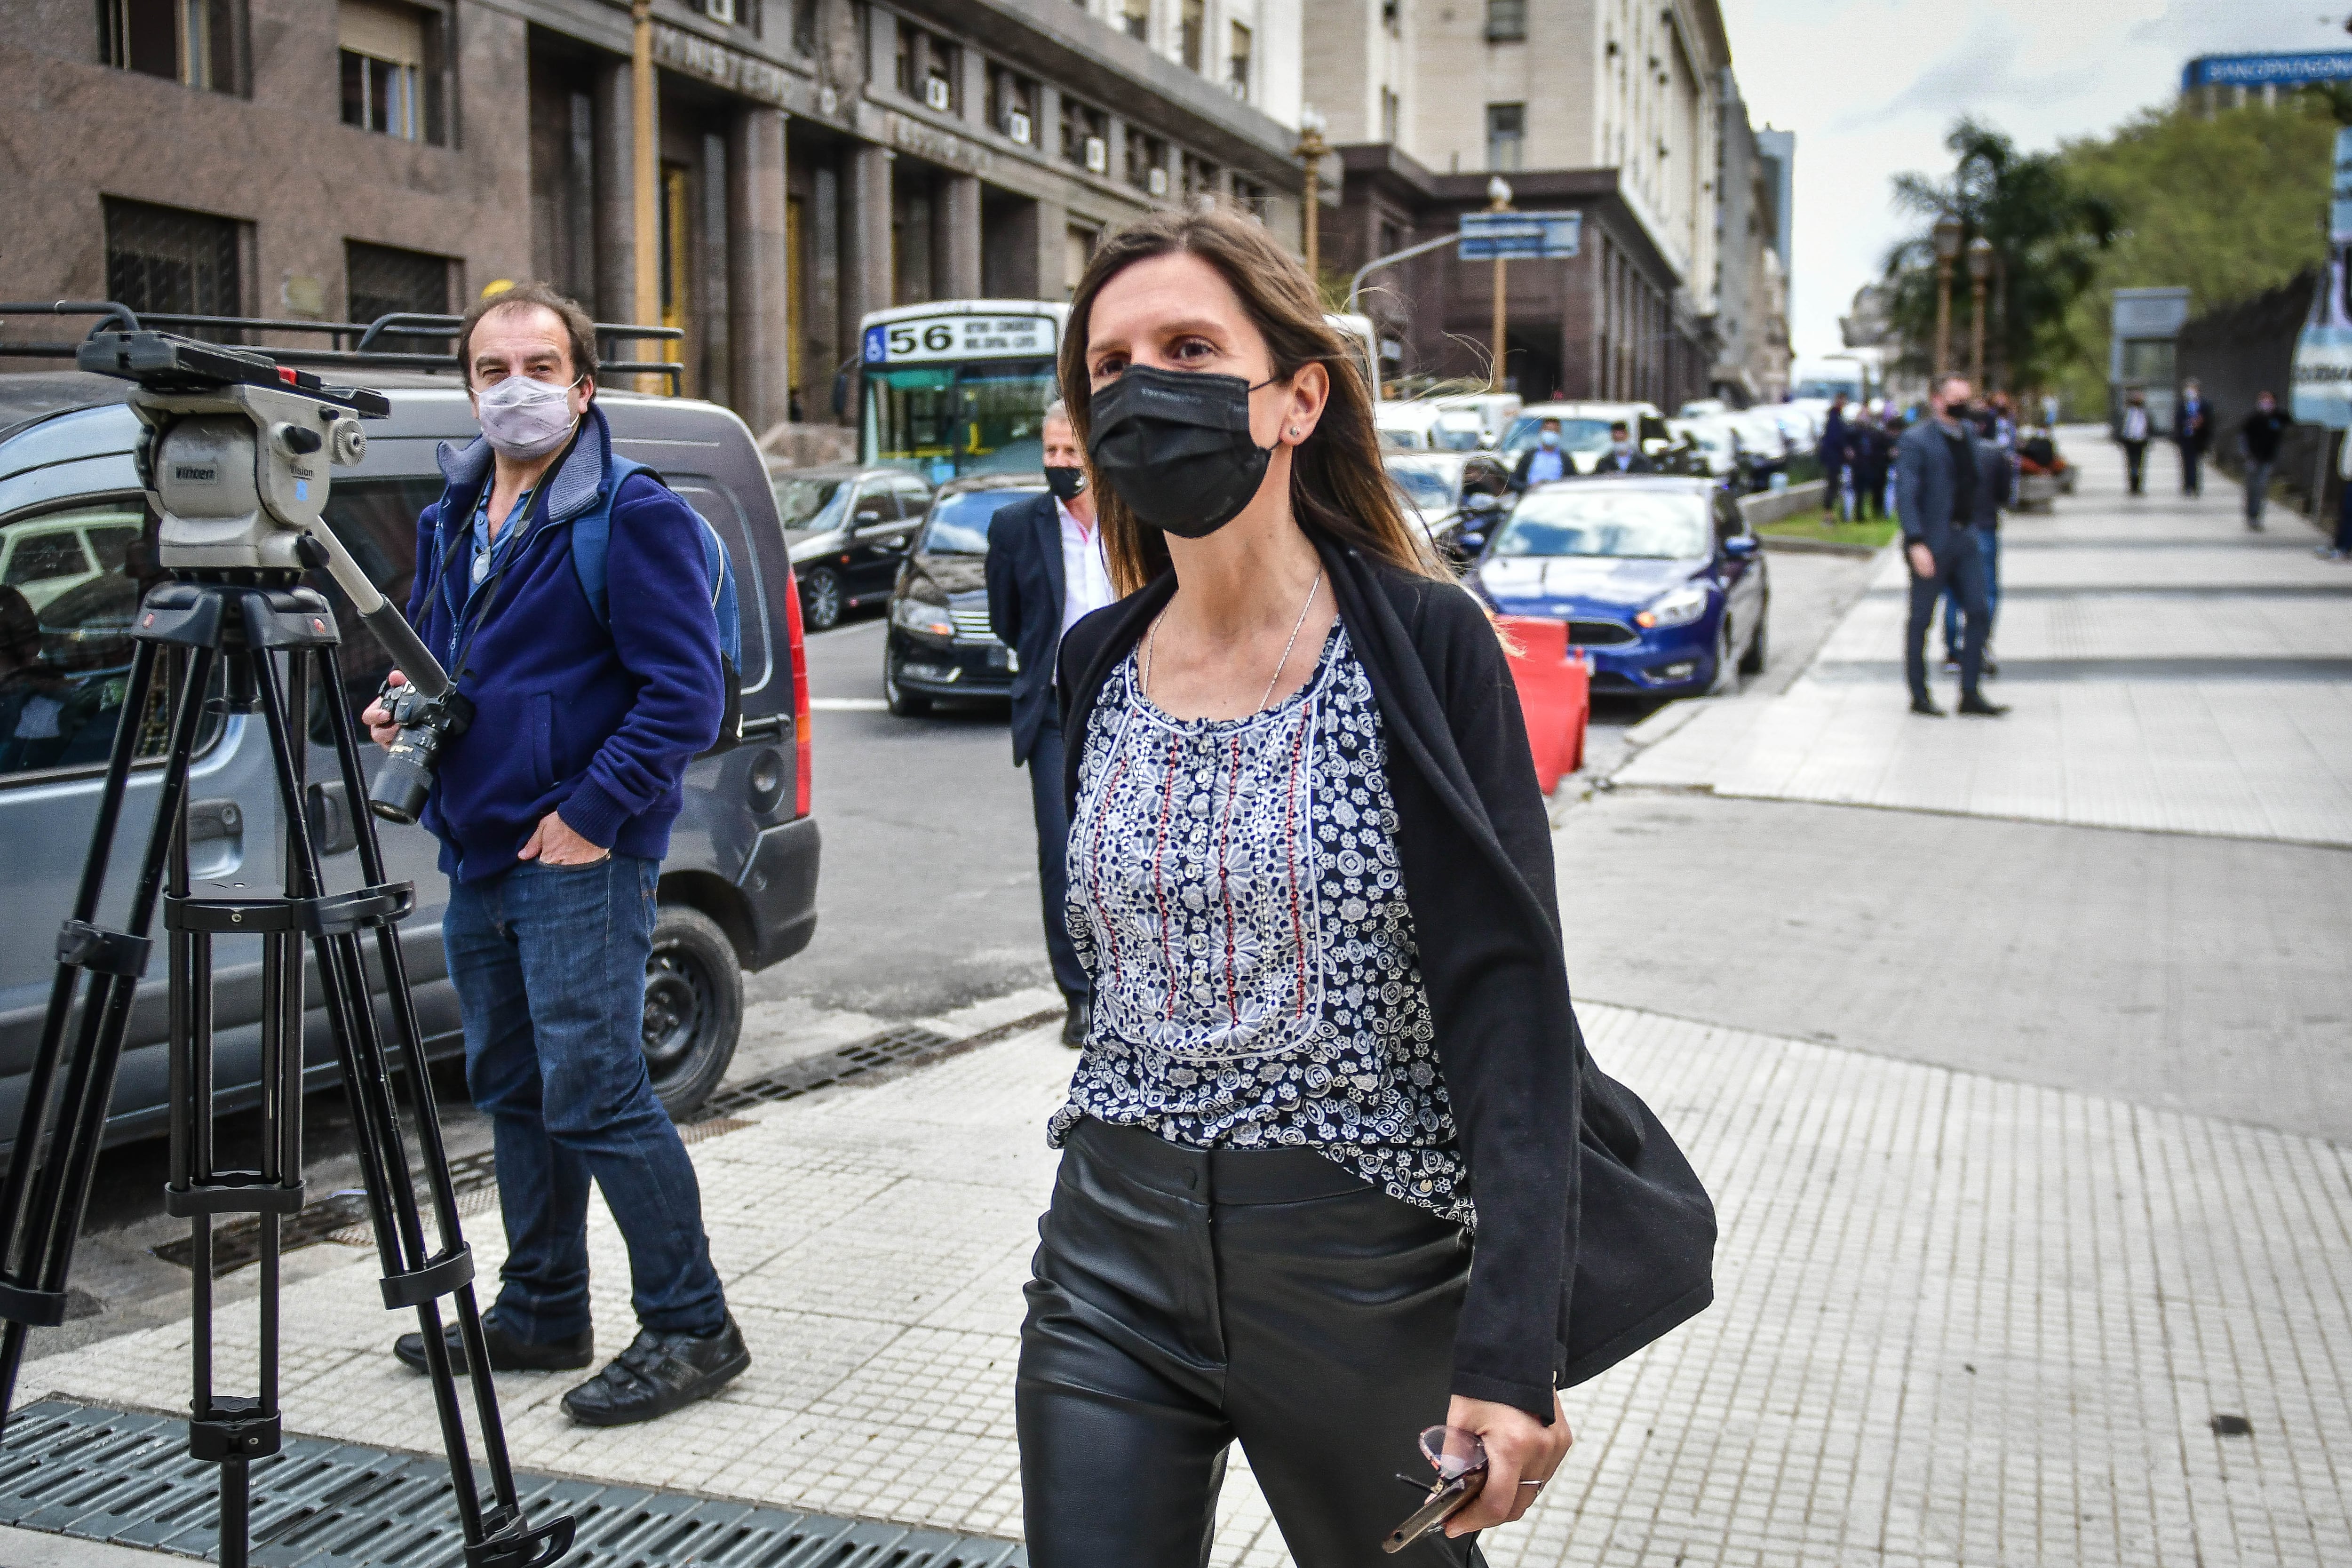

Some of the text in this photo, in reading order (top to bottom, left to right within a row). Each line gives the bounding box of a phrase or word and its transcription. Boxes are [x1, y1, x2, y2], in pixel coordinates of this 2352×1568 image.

[890, 324, 953, 354] 56
[289, 464, 314, 477] Vision
[296, 481, 308, 501] 8
